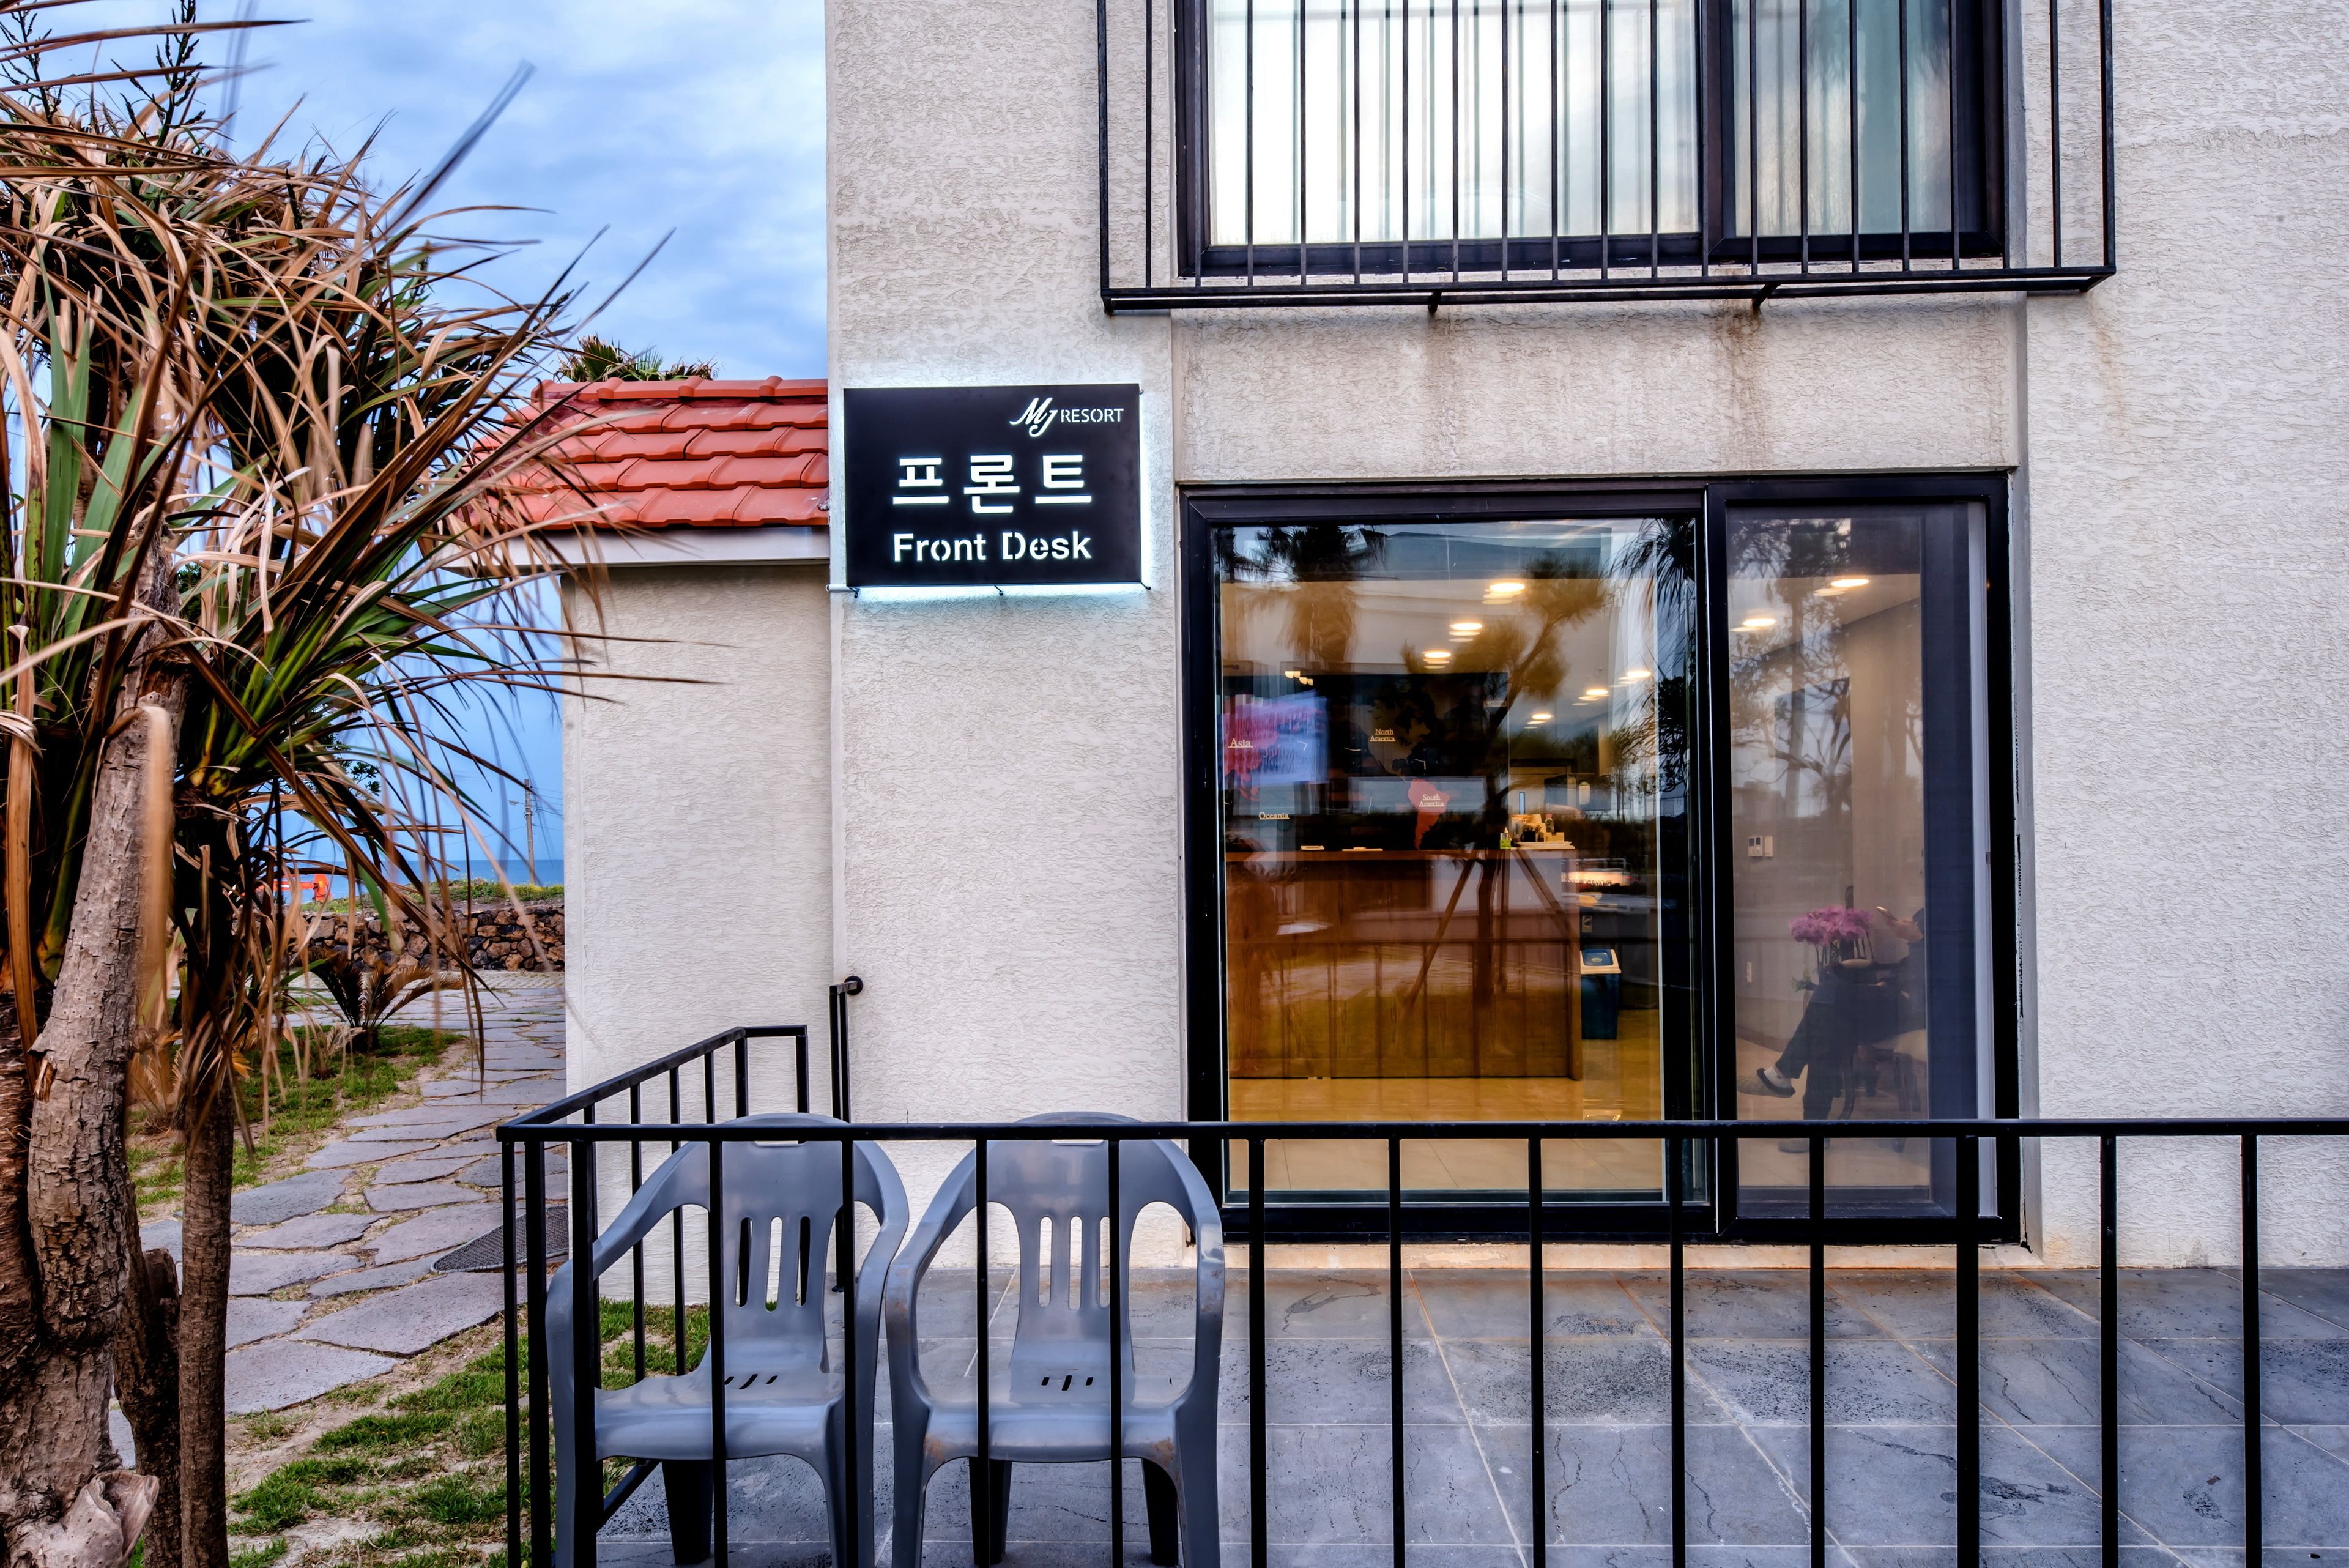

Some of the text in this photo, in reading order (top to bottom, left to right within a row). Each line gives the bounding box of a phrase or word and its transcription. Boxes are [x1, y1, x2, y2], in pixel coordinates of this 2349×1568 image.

[1060, 407, 1125, 423] RESORT
[892, 454, 1093, 514] 프론트
[893, 530, 1093, 562] Front Desk
[1228, 738, 1253, 748] Asia
